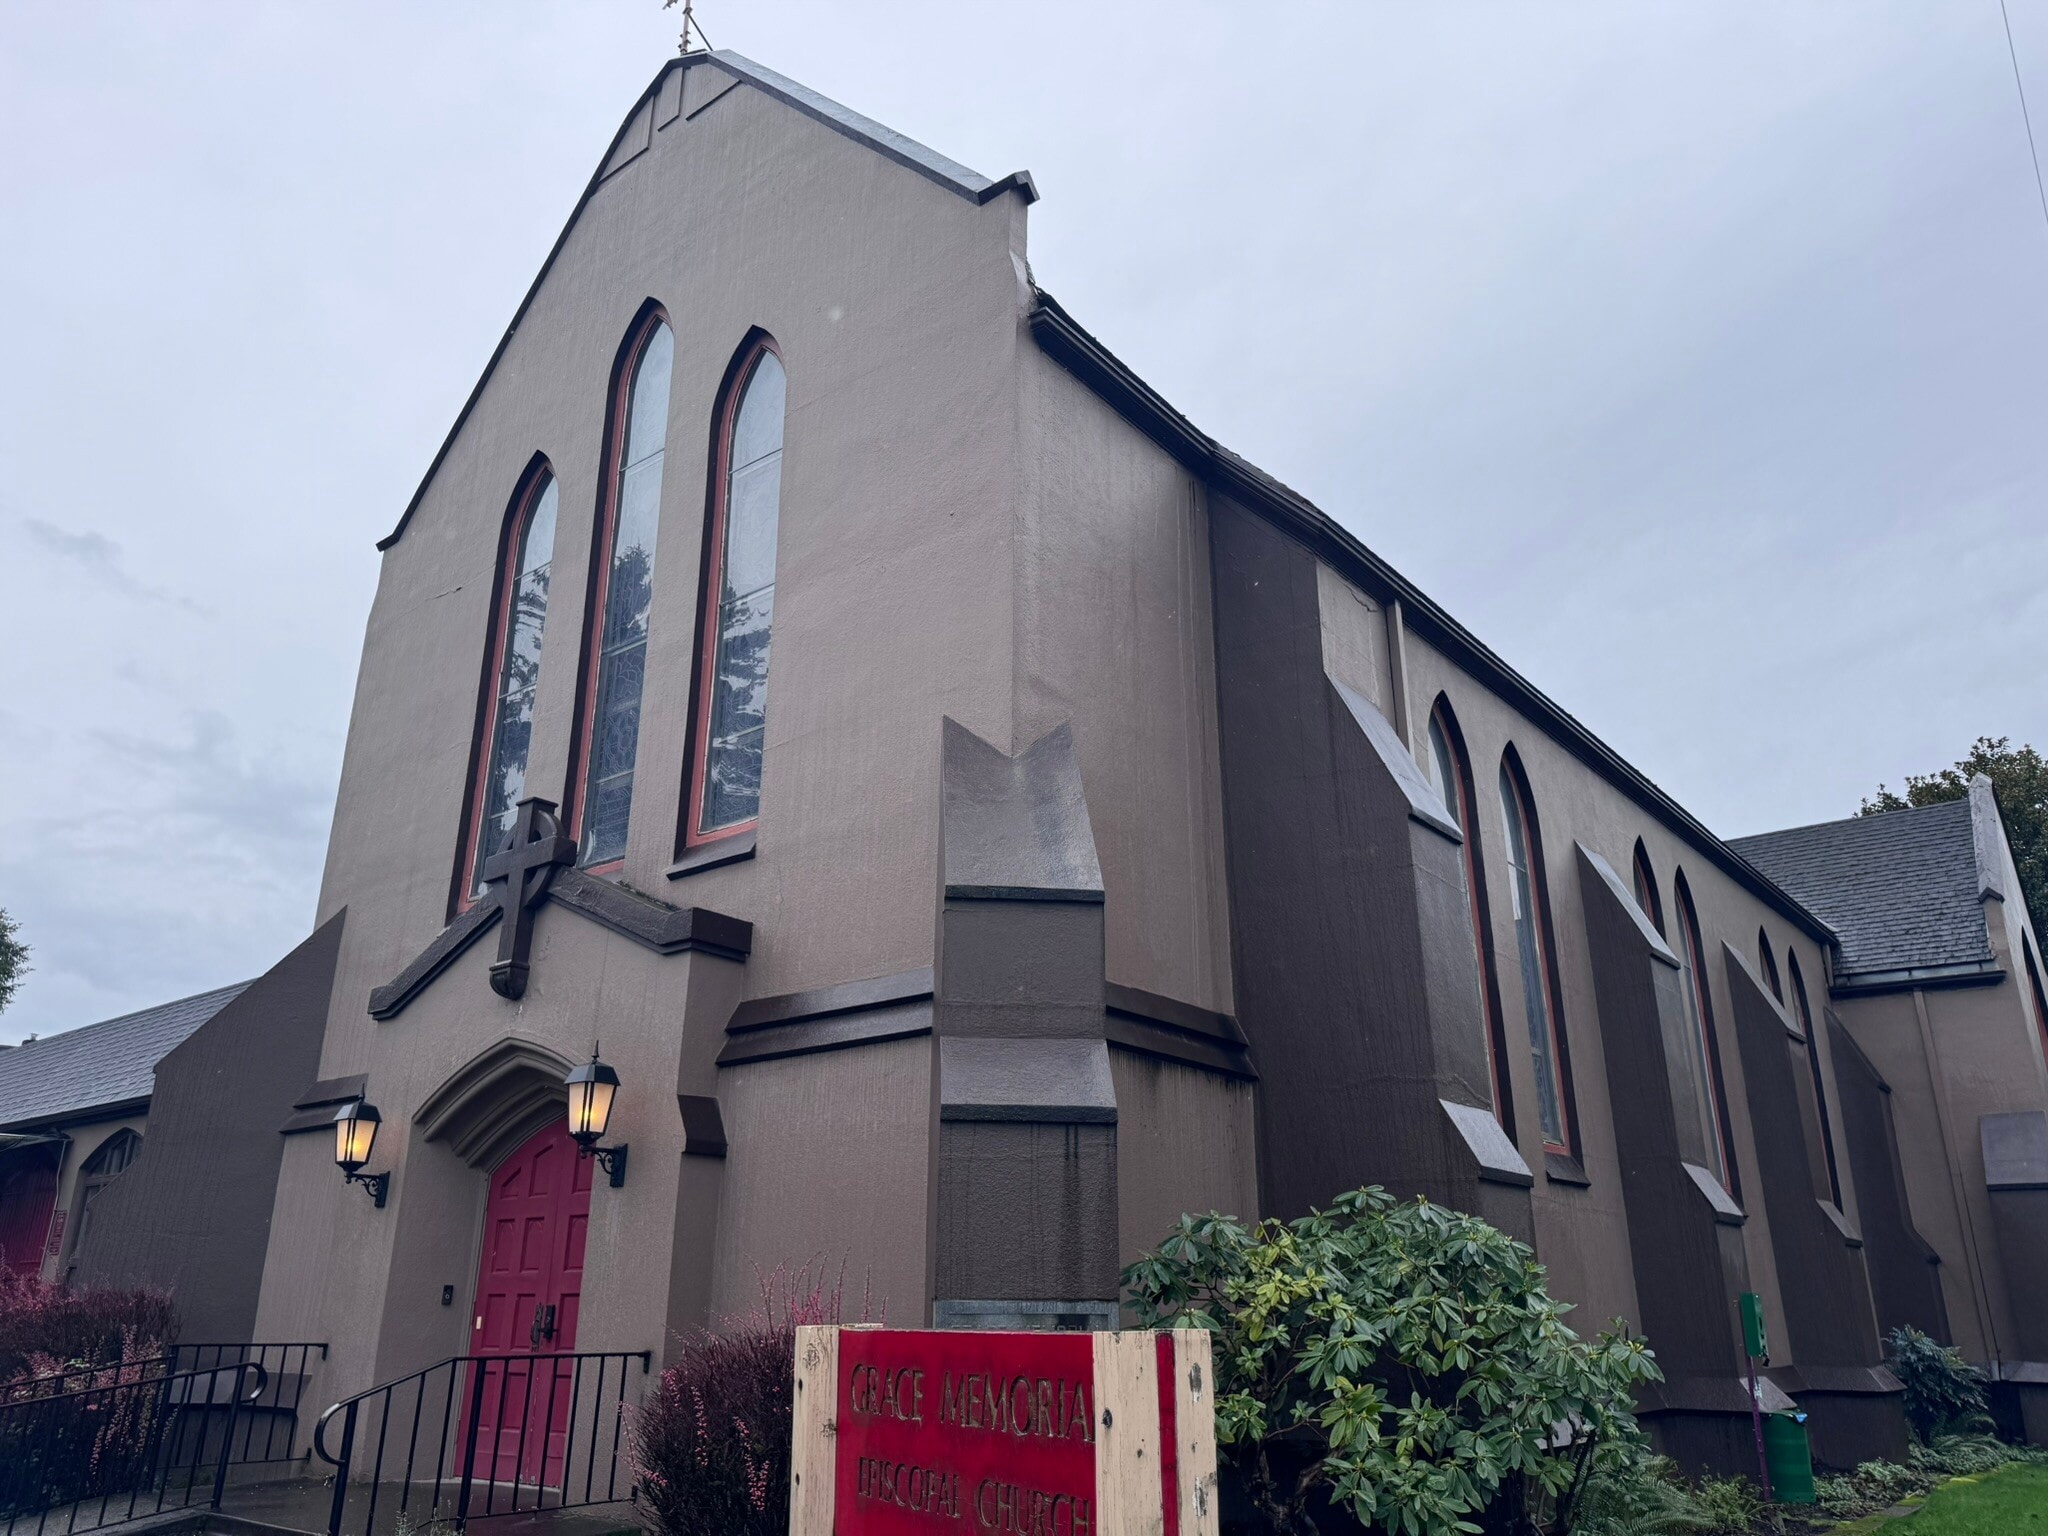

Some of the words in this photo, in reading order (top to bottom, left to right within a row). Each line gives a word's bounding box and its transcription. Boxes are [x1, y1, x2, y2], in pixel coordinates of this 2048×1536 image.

[852, 1363, 925, 1422] GRACE
[940, 1372, 1095, 1443] MEMORIA
[859, 1456, 961, 1518] EPISCOPAL
[978, 1478, 1090, 1536] CHURCH
